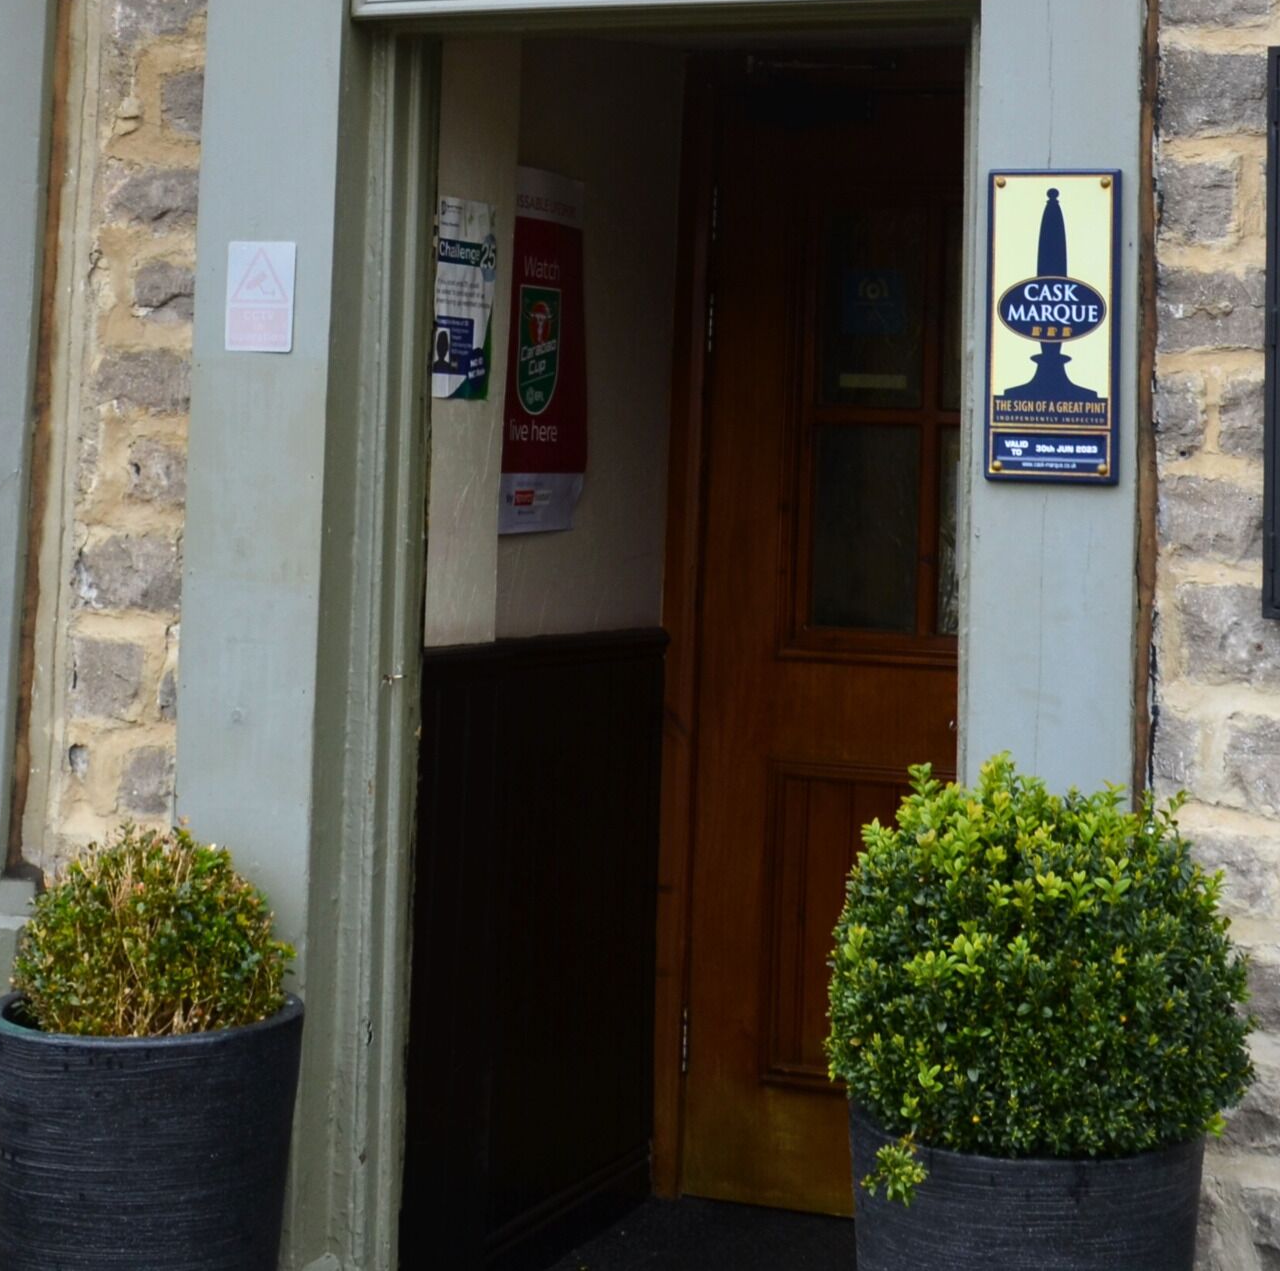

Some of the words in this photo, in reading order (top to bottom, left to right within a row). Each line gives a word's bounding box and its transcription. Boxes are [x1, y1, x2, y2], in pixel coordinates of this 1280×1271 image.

[439, 240, 480, 264] Challenge
[479, 242, 496, 270] 25
[524, 255, 560, 281] Watch
[1023, 282, 1080, 303] CASK
[1006, 304, 1099, 326] MARQUE
[528, 359, 546, 376] Cup
[995, 399, 1012, 412] THE
[1013, 400, 1034, 413] SIGN
[1035, 400, 1047, 413] OF
[1048, 401, 1055, 413] A
[1056, 401, 1084, 414] GREAT
[1085, 402, 1107, 415] PINT
[996, 415, 1059, 423] INDEPENDENTLY
[1062, 416, 1105, 424] INSPECTED
[510, 418, 529, 441] live
[531, 419, 558, 442] here
[1004, 439, 1029, 449] VALID
[1010, 448, 1023, 456] TO
